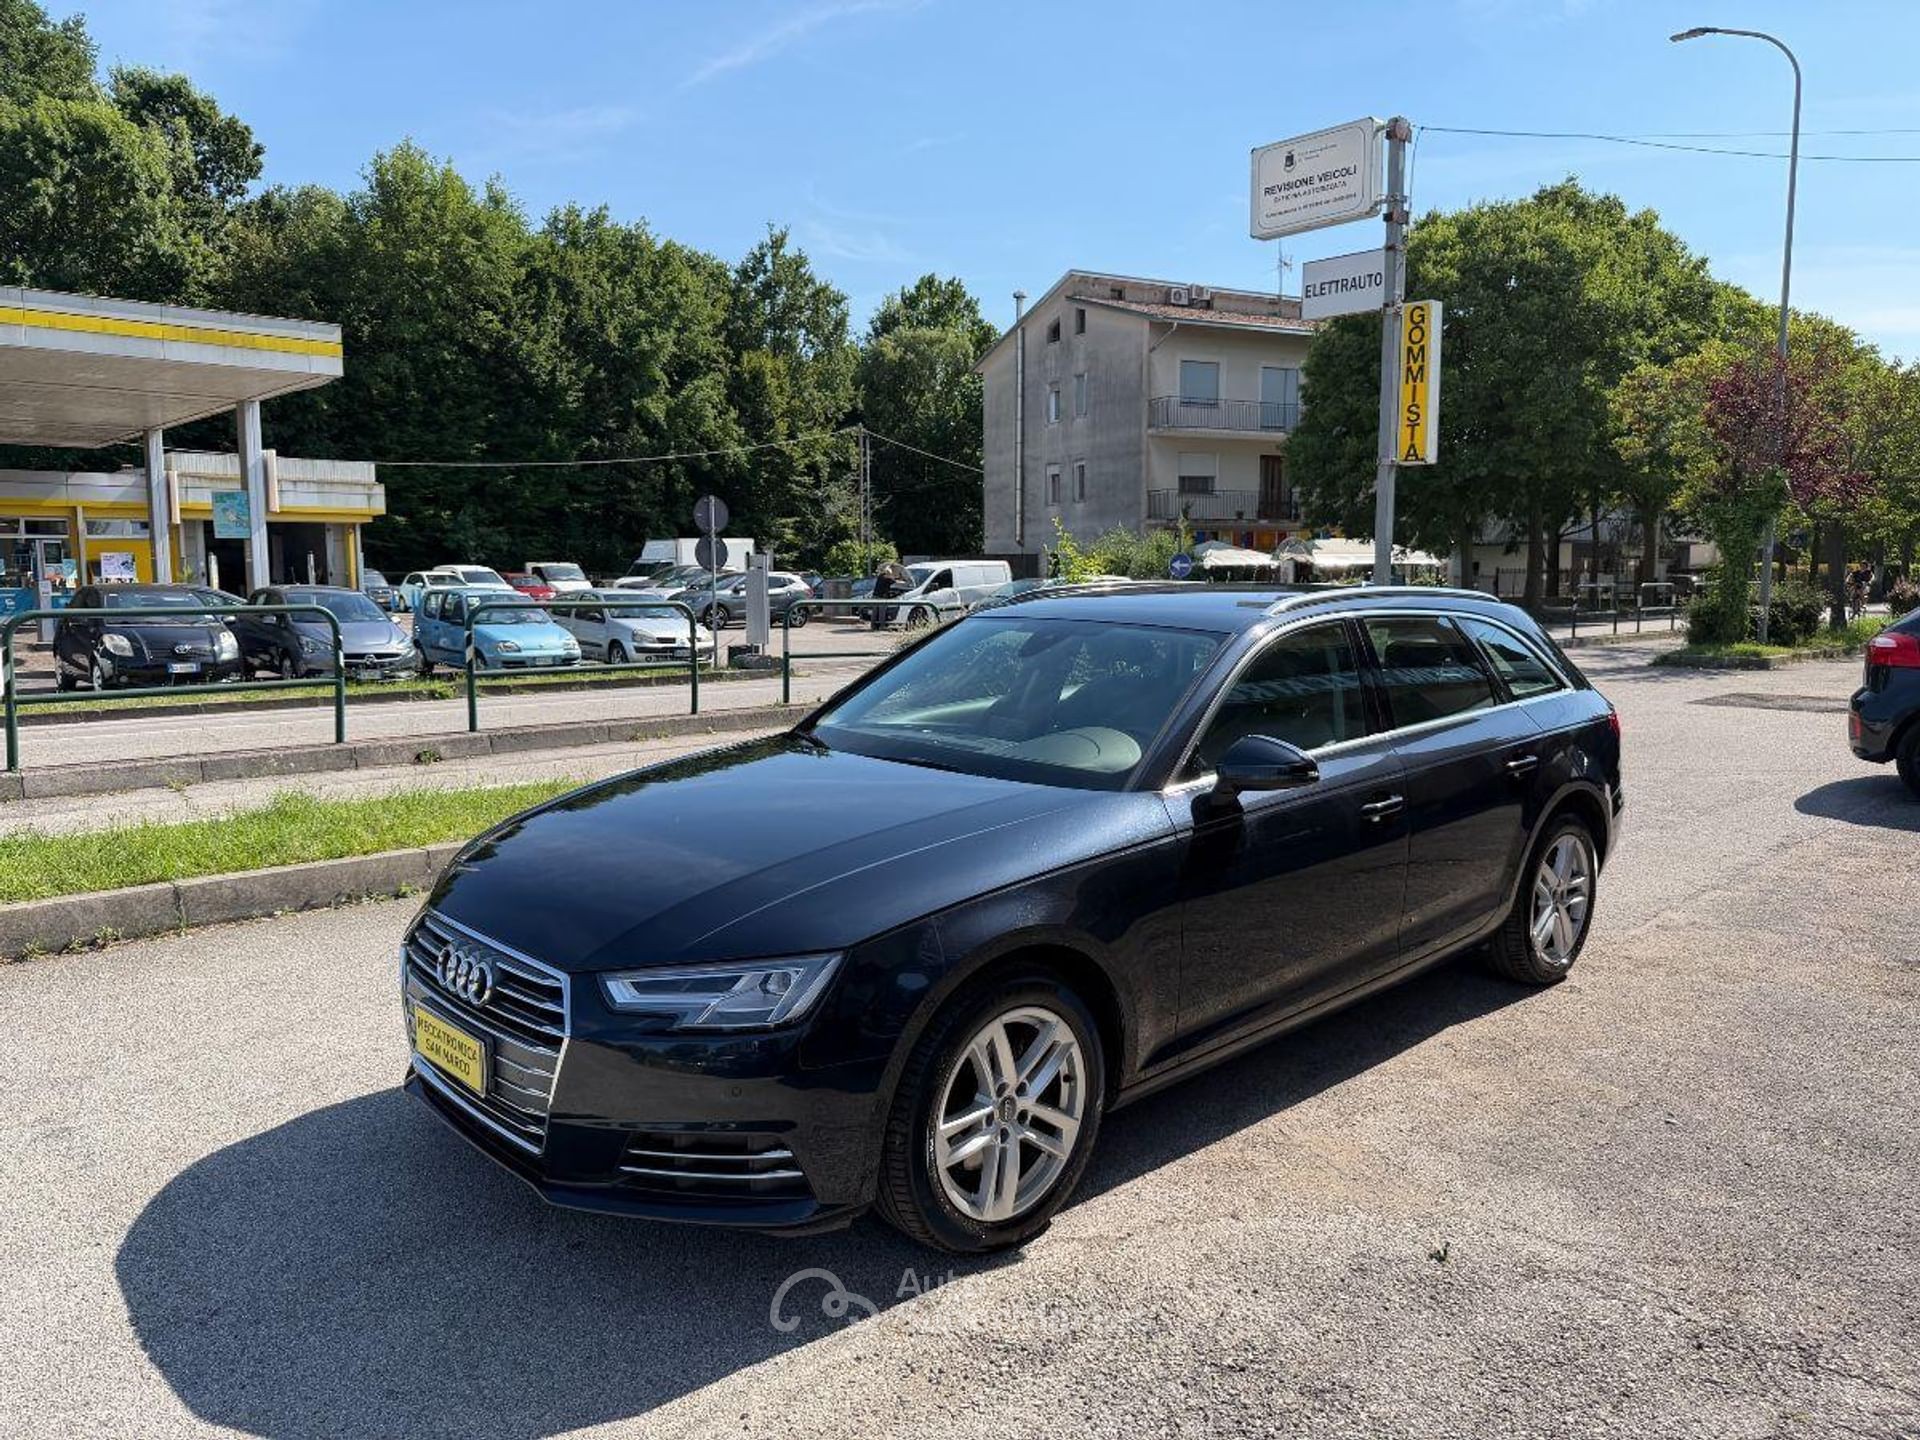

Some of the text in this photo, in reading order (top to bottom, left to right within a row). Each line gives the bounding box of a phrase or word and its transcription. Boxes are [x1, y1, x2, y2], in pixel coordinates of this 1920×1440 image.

[1264, 164, 1357, 197] REVISIONE VEICOLI
[1305, 272, 1383, 298] ELETTRAUTO
[1403, 305, 1426, 463] GOMMISTA
[425, 1038, 471, 1076] SAN MARCO
